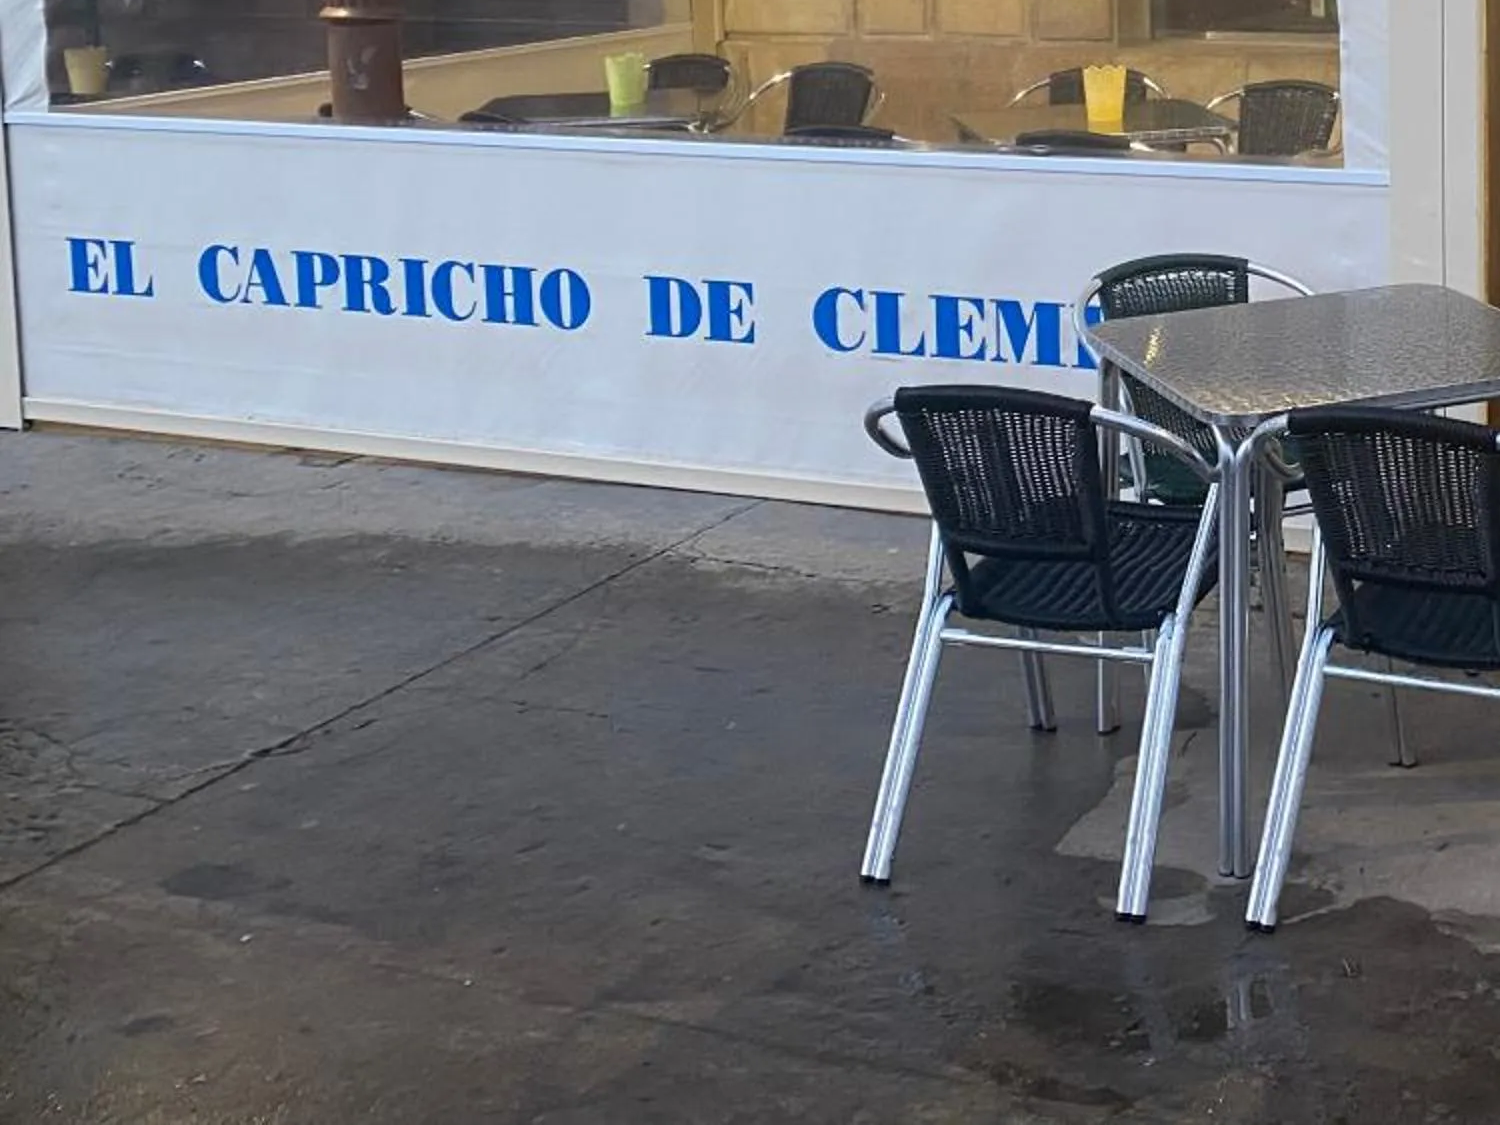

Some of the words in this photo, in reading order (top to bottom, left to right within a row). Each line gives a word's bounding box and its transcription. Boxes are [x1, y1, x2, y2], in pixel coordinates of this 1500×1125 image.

[66, 237, 153, 298] EL
[197, 243, 593, 332] CAPRICHO
[644, 275, 756, 345] DE
